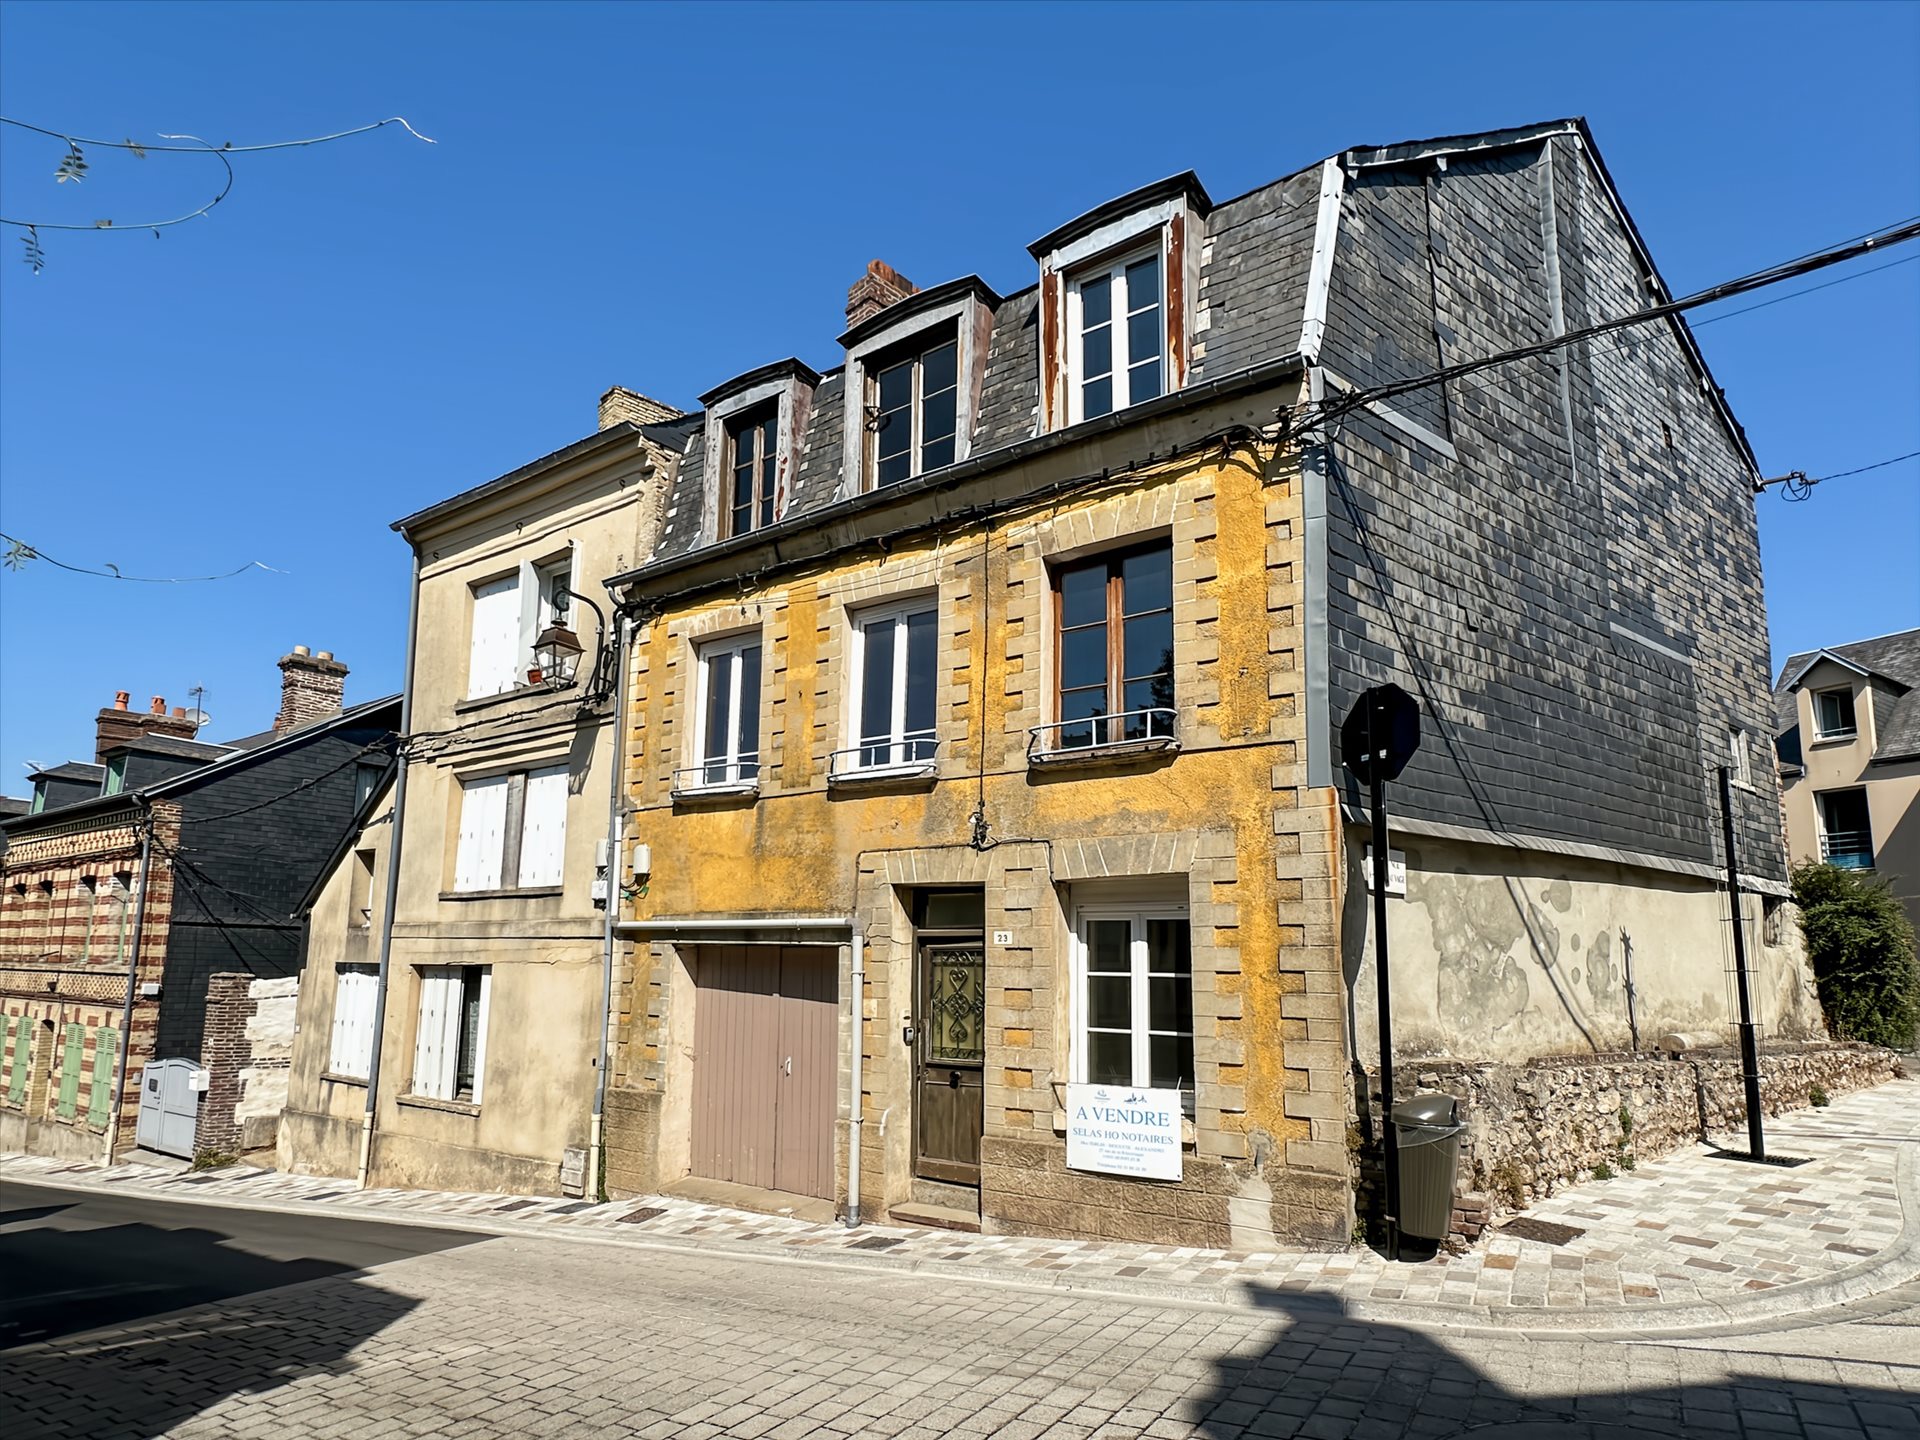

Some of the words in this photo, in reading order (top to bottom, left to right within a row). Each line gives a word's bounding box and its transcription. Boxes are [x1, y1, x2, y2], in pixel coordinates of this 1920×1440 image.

[997, 934, 1008, 943] 23
[1076, 1106, 1088, 1120] A
[1092, 1107, 1170, 1127] VENDRE
[1072, 1127, 1102, 1139] SELAS
[1104, 1130, 1120, 1141] HO
[1121, 1131, 1174, 1145] NOTAIRES
